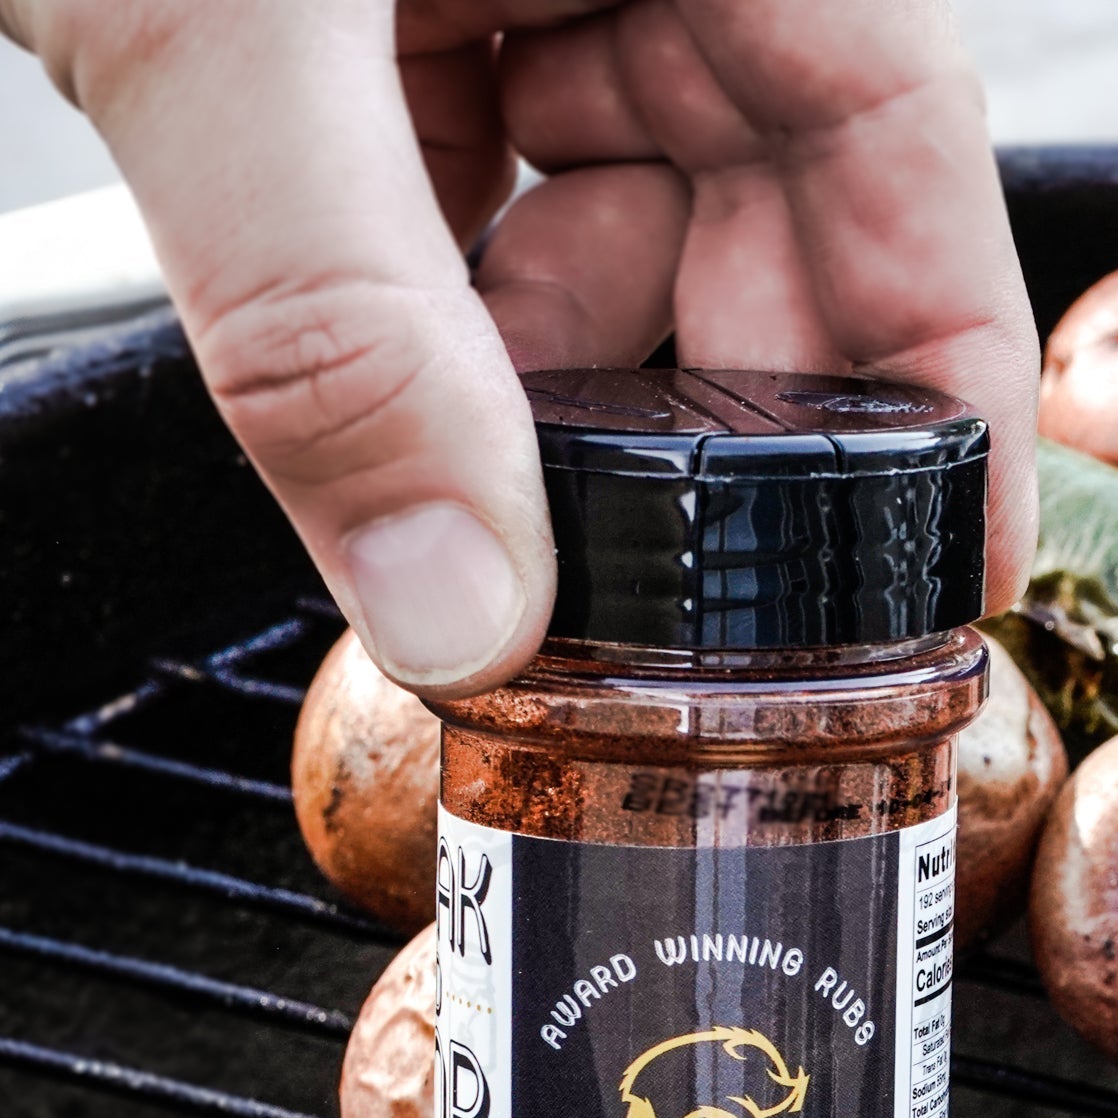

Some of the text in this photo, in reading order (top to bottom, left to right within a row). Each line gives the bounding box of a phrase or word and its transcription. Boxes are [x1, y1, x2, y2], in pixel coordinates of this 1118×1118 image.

[920, 892, 933, 909] 192
[918, 913, 944, 934] Serving
[540, 934, 875, 1050] AWARD WINNING RUBS
[915, 1022, 931, 1039] Total
[932, 1017, 940, 1032] Fat
[913, 1082, 936, 1099] Sodium
[912, 1102, 929, 1118] Total
